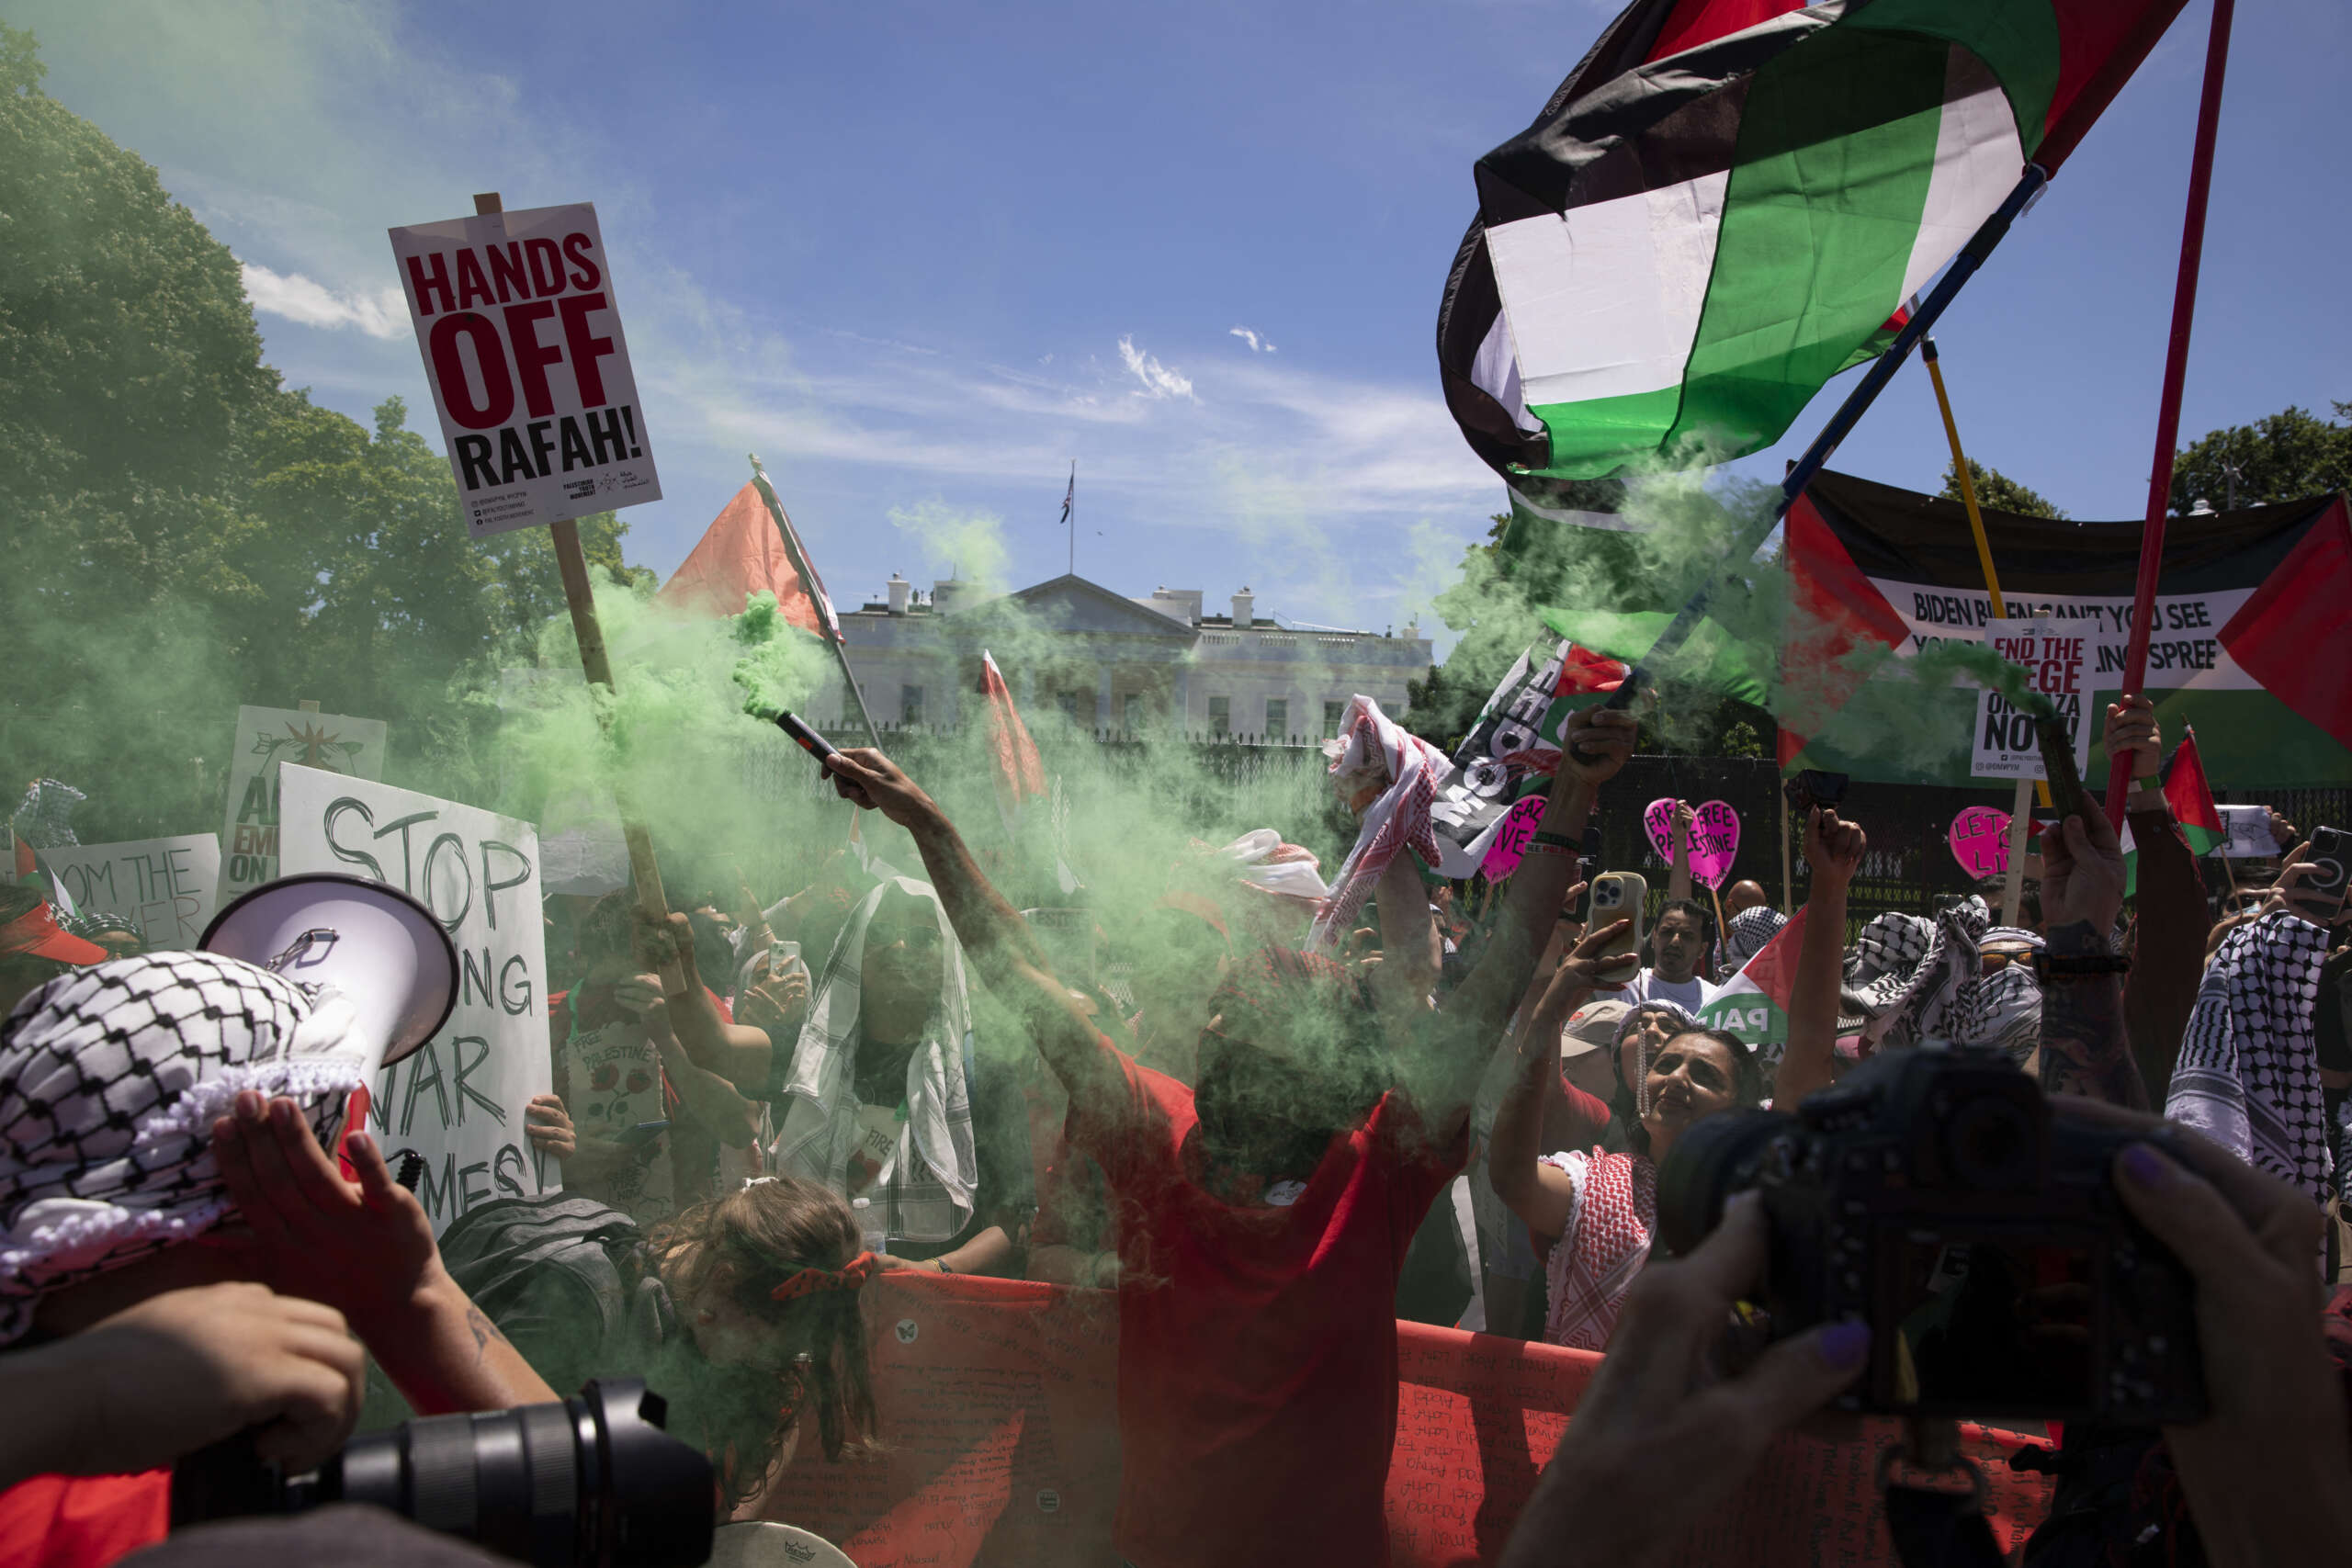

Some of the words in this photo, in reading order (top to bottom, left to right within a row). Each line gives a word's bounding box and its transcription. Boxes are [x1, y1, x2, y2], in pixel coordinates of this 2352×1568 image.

[406, 232, 601, 316] HANDS
[429, 292, 615, 429] OFF
[454, 405, 641, 491] RAFAH!
[1913, 592, 1973, 626] BIDEN
[1974, 599, 2031, 626] BIEN
[2166, 602, 2211, 630] SEE
[1994, 637, 2035, 660] END
[2041, 637, 2085, 660] THE
[2148, 638, 2217, 670] SPREE
[2012, 660, 2083, 694] EGE
[1984, 715, 2080, 754] NO!
[1511, 798, 1547, 829] GAZ
[1697, 804, 1733, 835] FREE
[1955, 814, 2001, 840] LET
[62, 861, 118, 908] OM
[121, 849, 202, 903] THE
[229, 854, 267, 883] ON
[323, 796, 533, 934] STOP
[573, 1028, 602, 1054] FREE
[583, 1045, 652, 1072] PALESTINE
